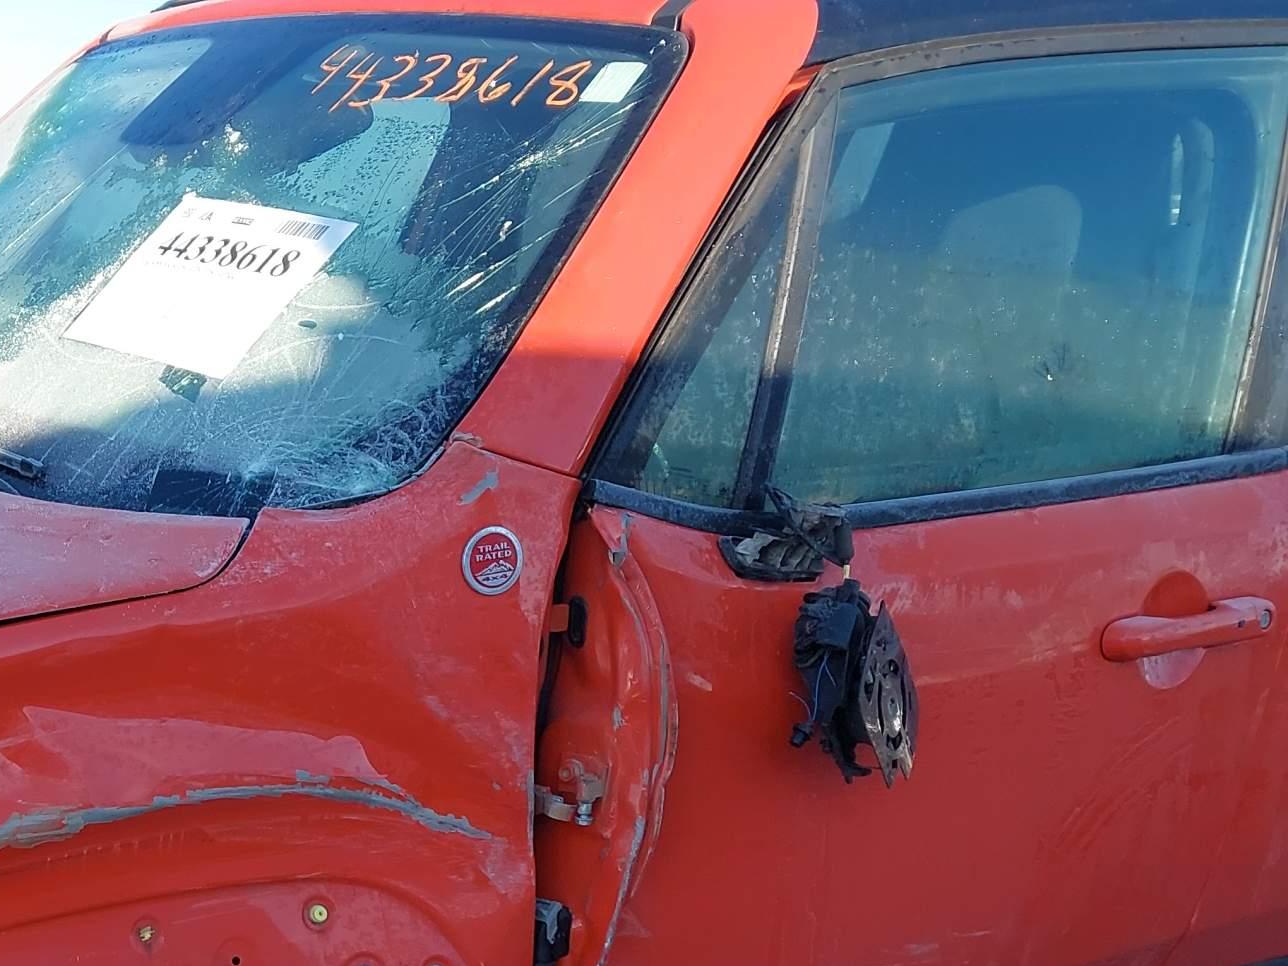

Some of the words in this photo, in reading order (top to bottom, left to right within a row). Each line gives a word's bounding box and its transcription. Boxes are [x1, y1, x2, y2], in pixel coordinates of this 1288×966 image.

[311, 44, 593, 113] 44338618
[158, 232, 301, 277] 44338618
[475, 550, 512, 562] RATED
[477, 541, 510, 553] TRAIL
